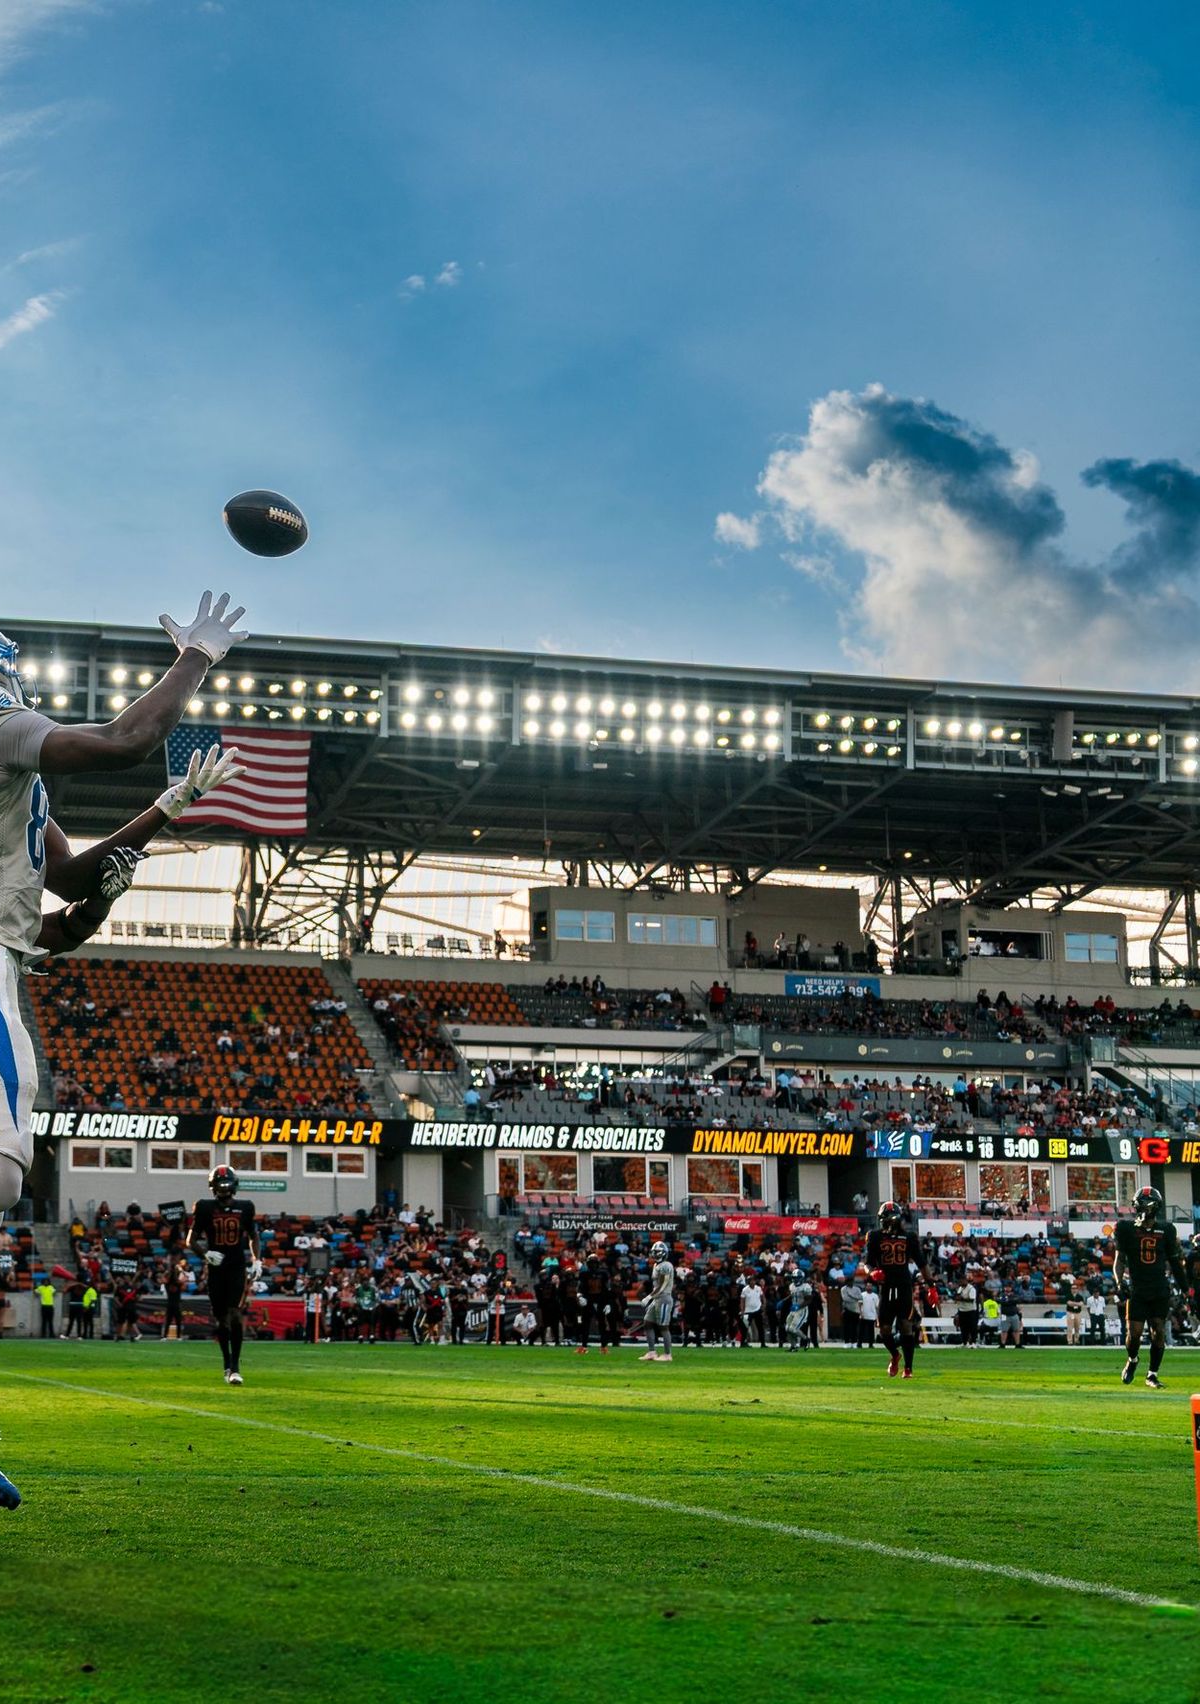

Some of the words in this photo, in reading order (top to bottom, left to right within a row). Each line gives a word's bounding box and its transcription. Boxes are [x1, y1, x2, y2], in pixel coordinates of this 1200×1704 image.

[51, 1113, 76, 1136] DE
[76, 1113, 179, 1139] ACCIDENTES
[212, 1115, 260, 1143] (713)
[261, 1119, 383, 1144] G-A-N-A-D-O-R
[411, 1123, 497, 1147] HERIBERTO
[498, 1125, 553, 1148] RAMOS
[557, 1127, 570, 1149] &
[572, 1127, 665, 1151] ASSOCIATES
[692, 1130, 853, 1156] DYNAMOLAWYER.COM
[910, 1135, 922, 1156] 0
[978, 1143, 994, 1159] 18
[1004, 1138, 1040, 1158] 5:00
[1069, 1143, 1089, 1156] 2nd
[1119, 1139, 1132, 1160] 9
[213, 1218, 240, 1245] 18
[614, 1221, 647, 1231] Cancer
[648, 1221, 677, 1231] Center
[495, 1253, 506, 1269] 3
[880, 1242, 906, 1265] 26
